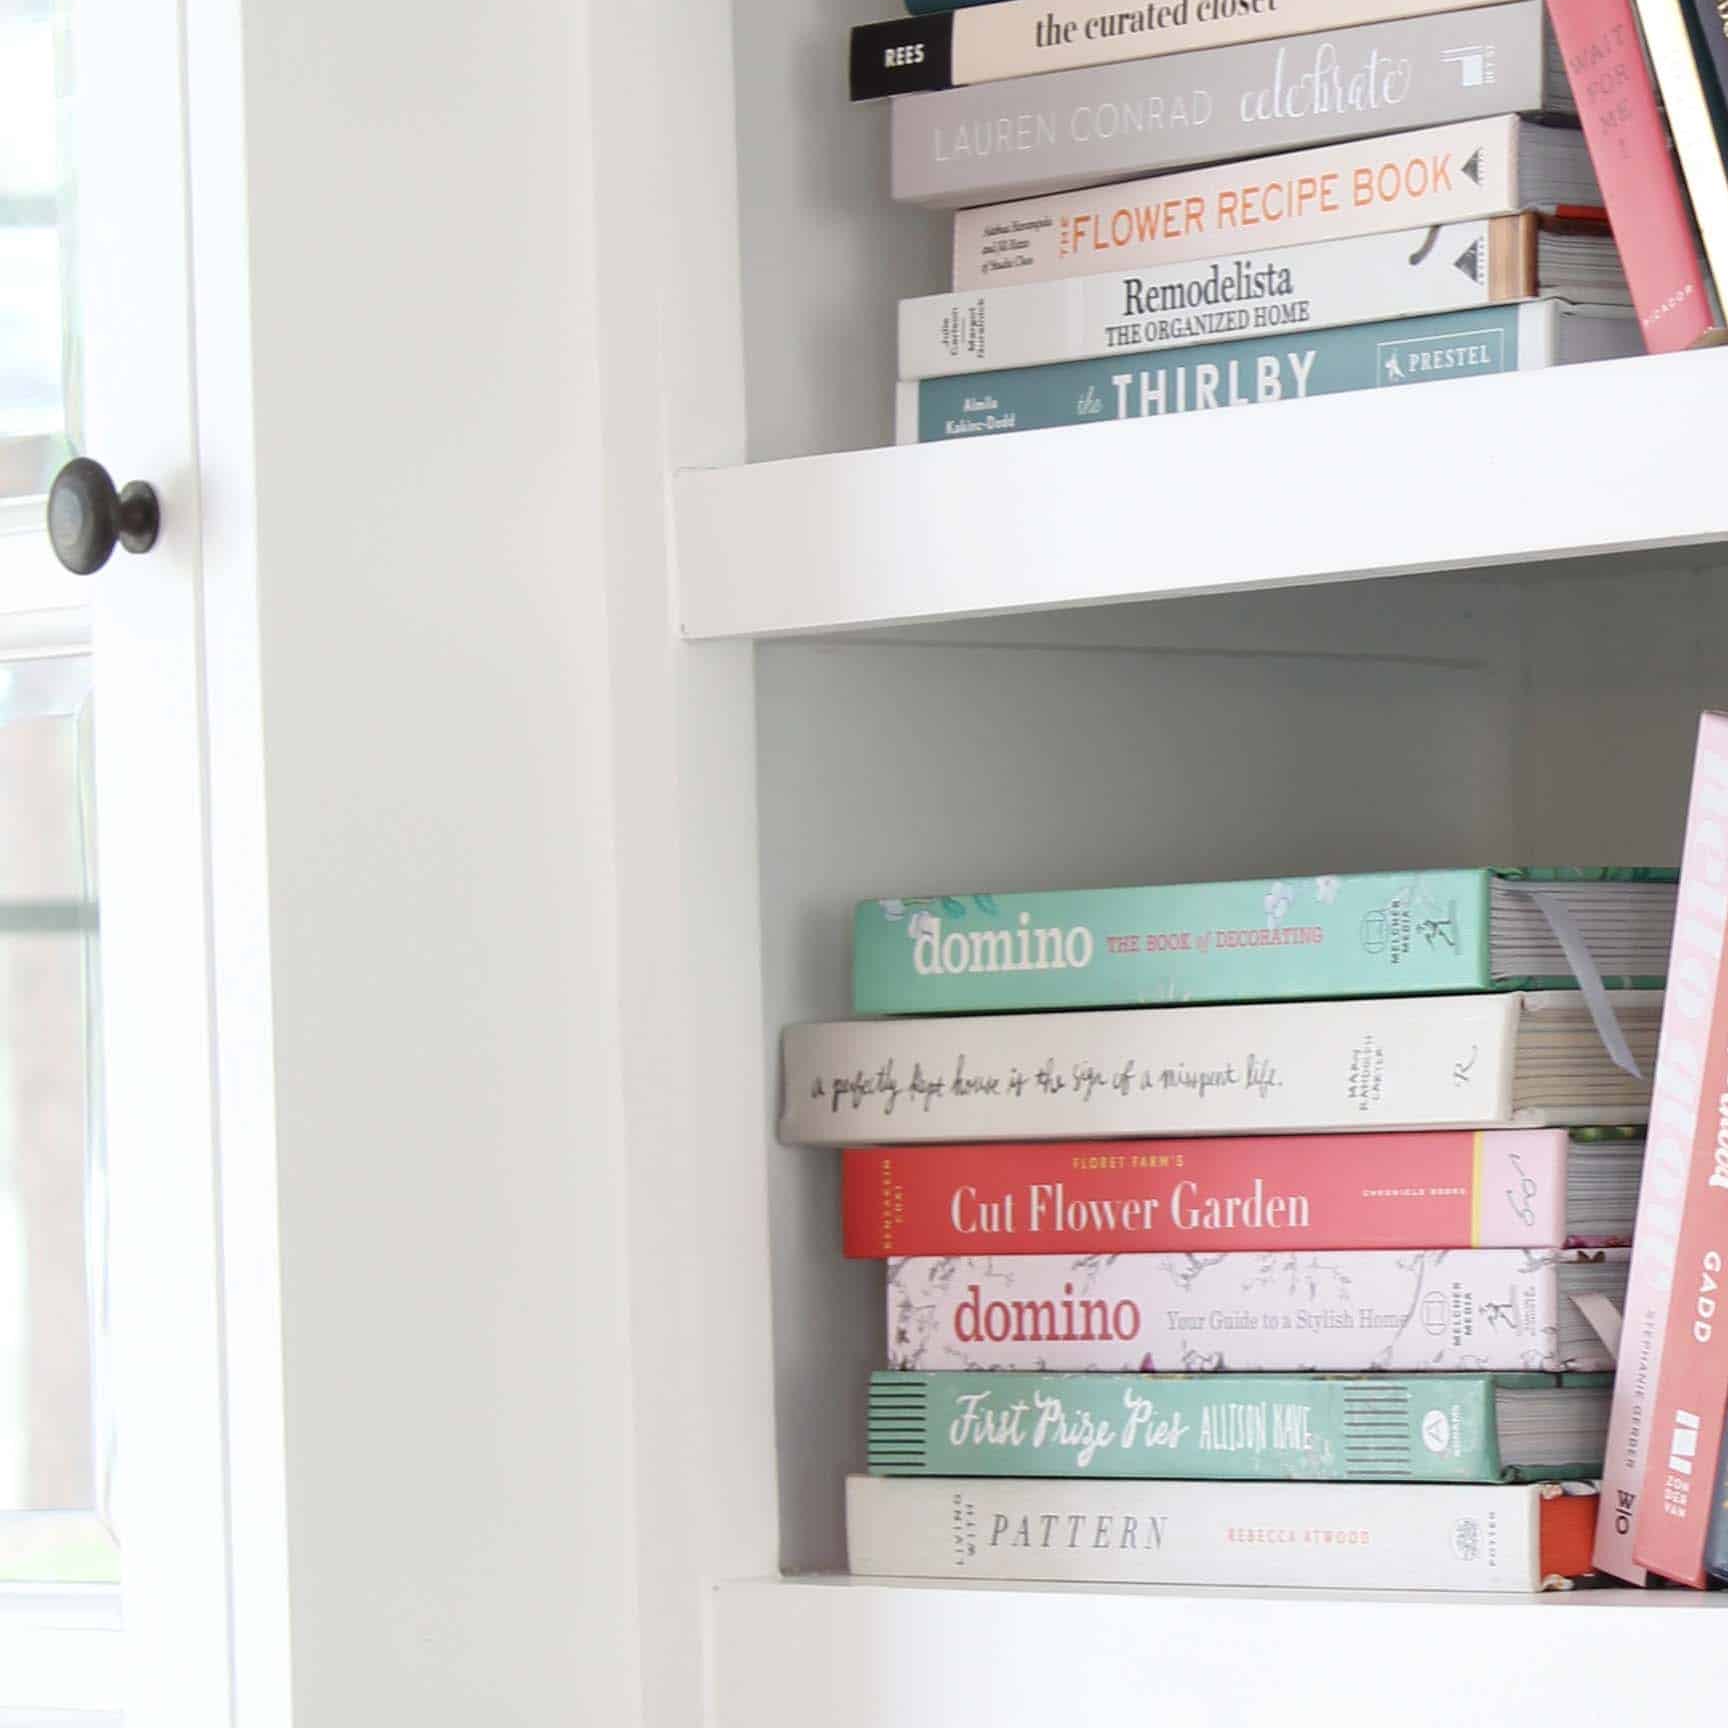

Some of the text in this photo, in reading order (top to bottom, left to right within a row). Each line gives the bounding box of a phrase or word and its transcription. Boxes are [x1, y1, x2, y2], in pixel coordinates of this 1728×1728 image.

[884, 42, 925, 68] REES
[1033, 8, 1078, 49] the
[933, 44, 1412, 163] LAUREN CONRAD celebrate
[1069, 196, 1207, 253] FLOWER
[1216, 172, 1340, 230] RECIPE
[1352, 153, 1453, 206] BOOK
[1122, 261, 1294, 318] Remodelista
[1105, 300, 1310, 348] THE ORGANIZED HOME
[1111, 350, 1318, 422] THIRLBY
[1407, 345, 1492, 373] PRESTEL
[913, 913, 1324, 978] domino THE BOOK DECORATING
[1072, 1154, 1184, 1171] FLORET FARM'S
[951, 1186, 1014, 1234] Cut
[1028, 1182, 1159, 1233] Flower
[1170, 1178, 1312, 1230] Garden
[953, 1283, 1355, 1345] domino Your Guide Stylish
[1453, 1282, 1461, 1346] MELCHER
[1464, 1292, 1472, 1336] MEDIA
[1693, 1248, 1723, 1345] GADD
[949, 1387, 1267, 1470] First Prize Pies ALLISON
[990, 1513, 1370, 1552] PATTERN REBECCA ATWOOD
